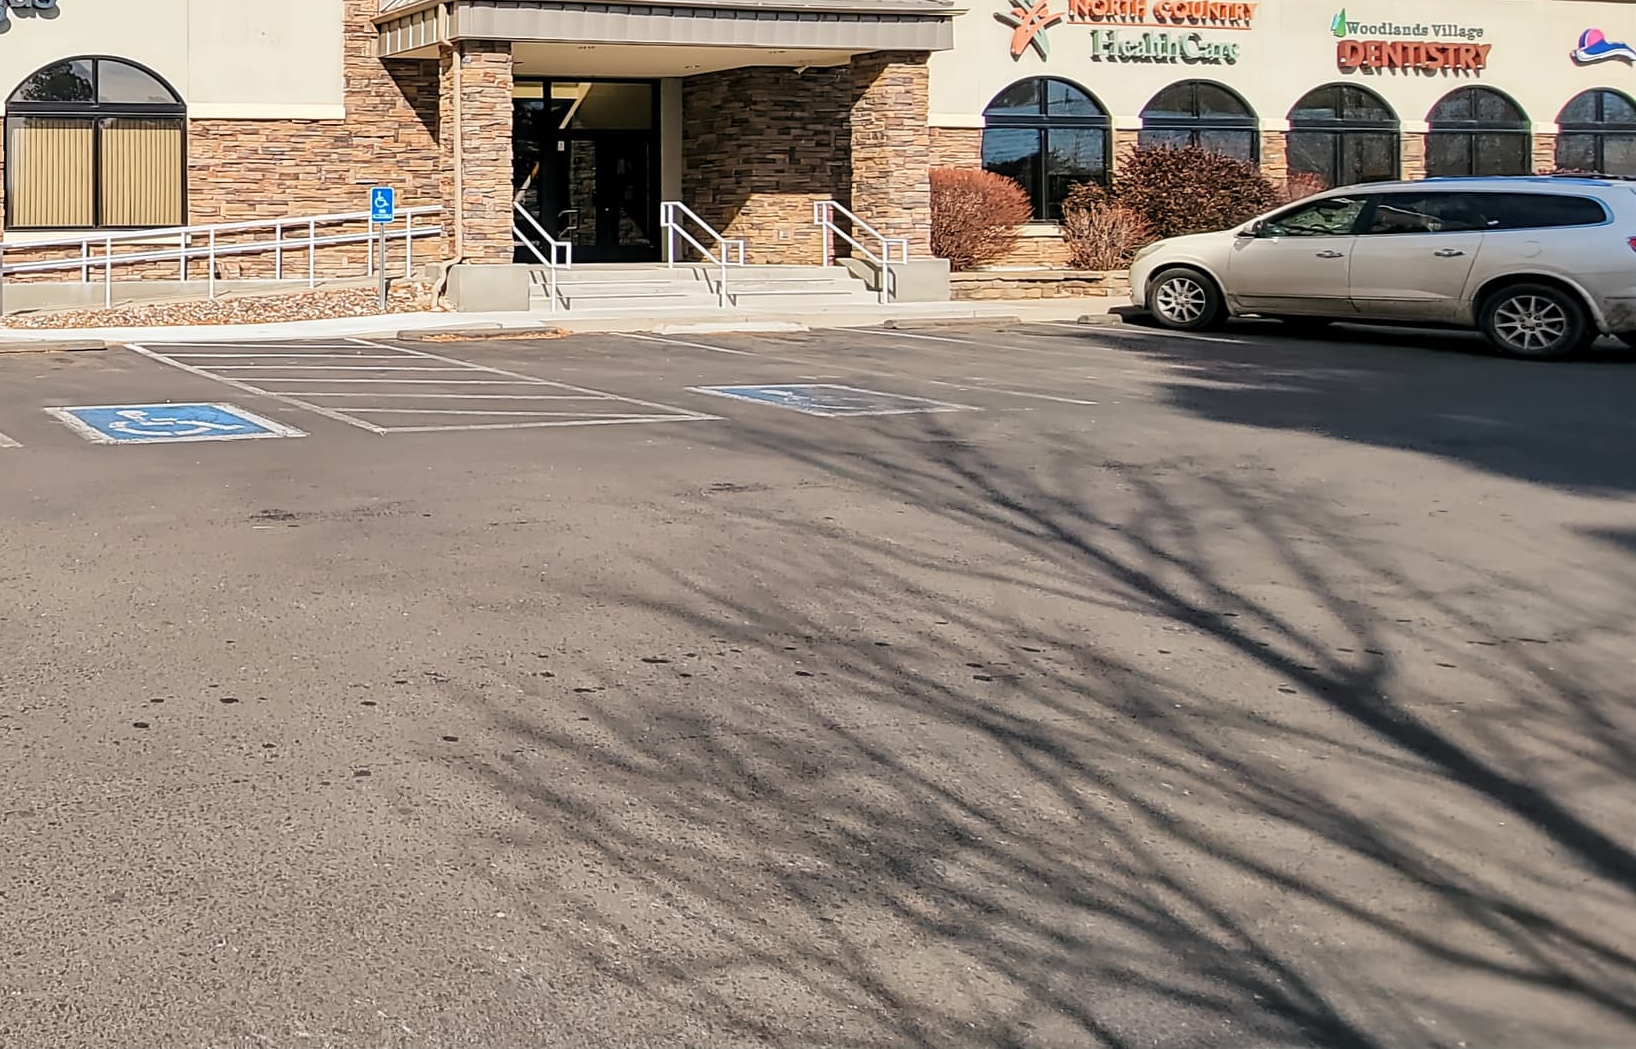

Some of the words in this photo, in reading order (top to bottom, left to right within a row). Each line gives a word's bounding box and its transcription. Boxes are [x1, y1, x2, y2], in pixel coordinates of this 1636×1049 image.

[1153, 0, 1258, 24] COUNTRY
[1346, 21, 1429, 37] Woodlands
[1432, 25, 1484, 40] Village
[1091, 30, 1240, 61] HealthCare
[1337, 41, 1492, 70] DENTISTRY
